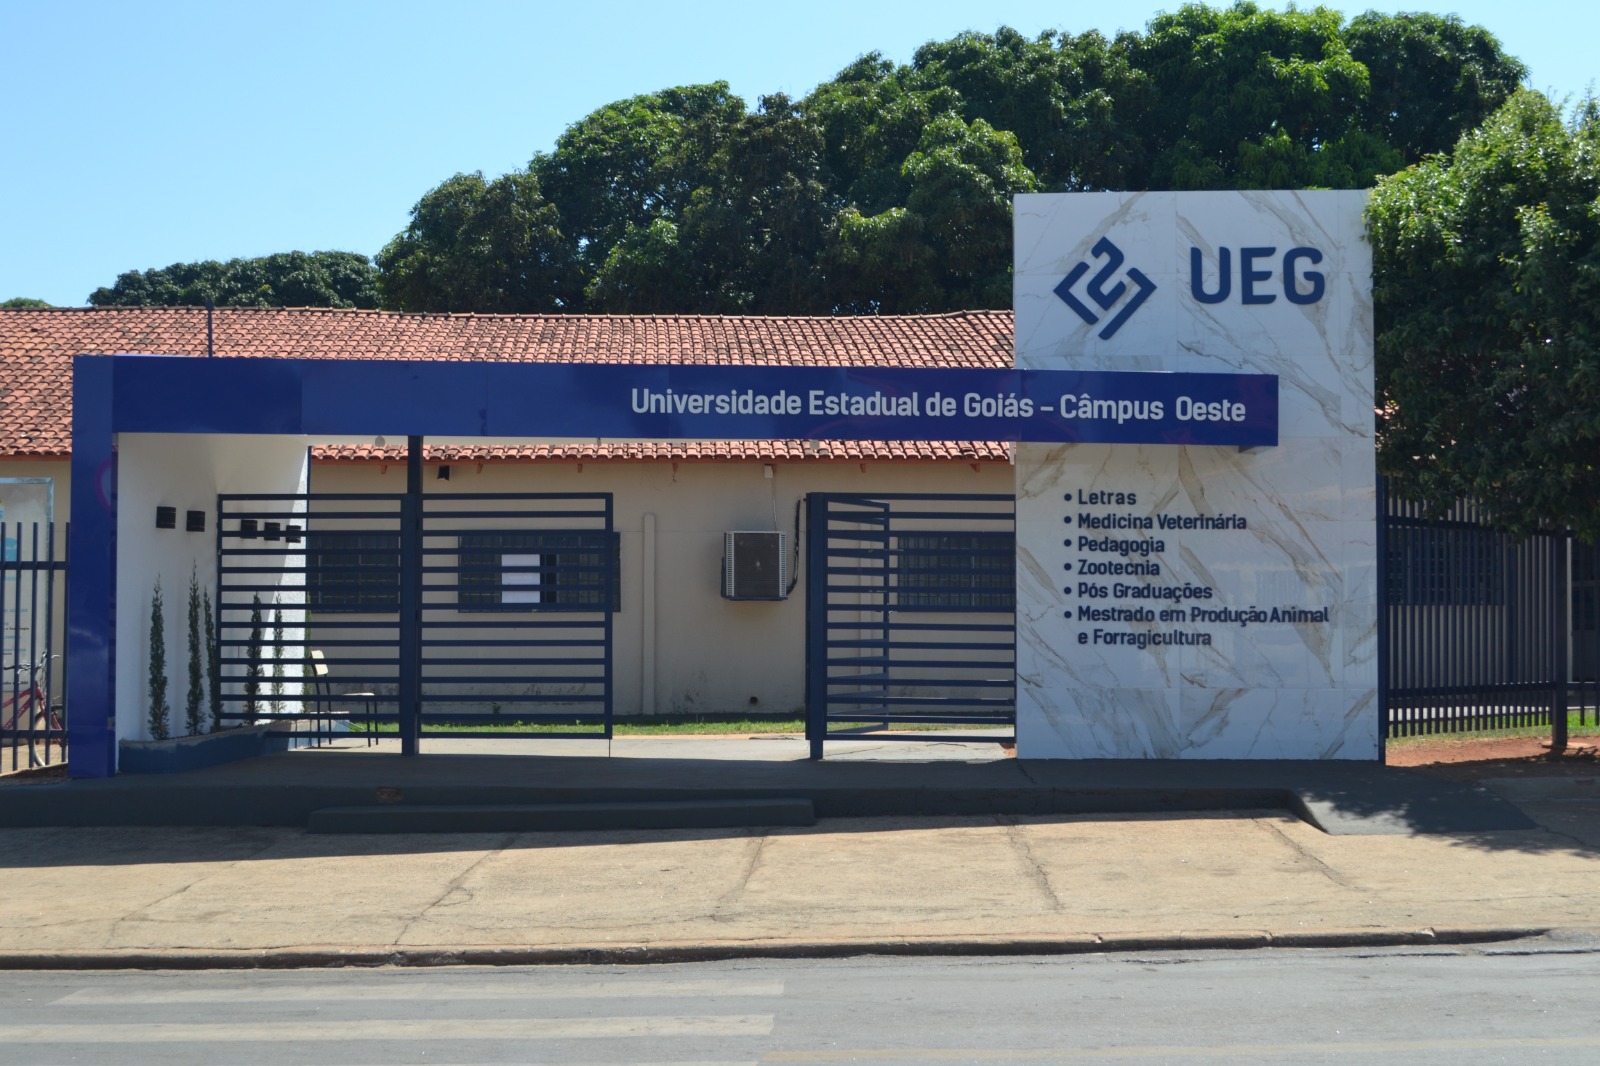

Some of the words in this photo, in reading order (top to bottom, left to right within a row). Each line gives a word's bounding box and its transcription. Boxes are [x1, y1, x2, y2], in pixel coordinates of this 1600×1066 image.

[1190, 246, 1325, 305] UEG
[631, 388, 801, 414] Universidade
[809, 390, 919, 416] Estadual
[925, 392, 957, 416] de
[963, 392, 1034, 417] Goiás
[1060, 393, 1164, 424] Câmpus
[1175, 396, 1246, 422] Oeste
[1078, 489, 1137, 505] Letras
[1078, 513, 1153, 530] Medicina
[1157, 513, 1247, 530] Veterinária
[1078, 536, 1165, 557] Pedagogia
[1078, 559, 1160, 576] Zootecnia
[1078, 582, 1108, 599] Pós
[1113, 582, 1213, 603] Graduações
[1078, 606, 1155, 622] Mestrado
[1159, 609, 1186, 622] em
[1190, 606, 1268, 627] Produção
[1270, 606, 1329, 623] Animal
[1078, 631, 1088, 645] e
[1093, 629, 1212, 649] Forragicultura
